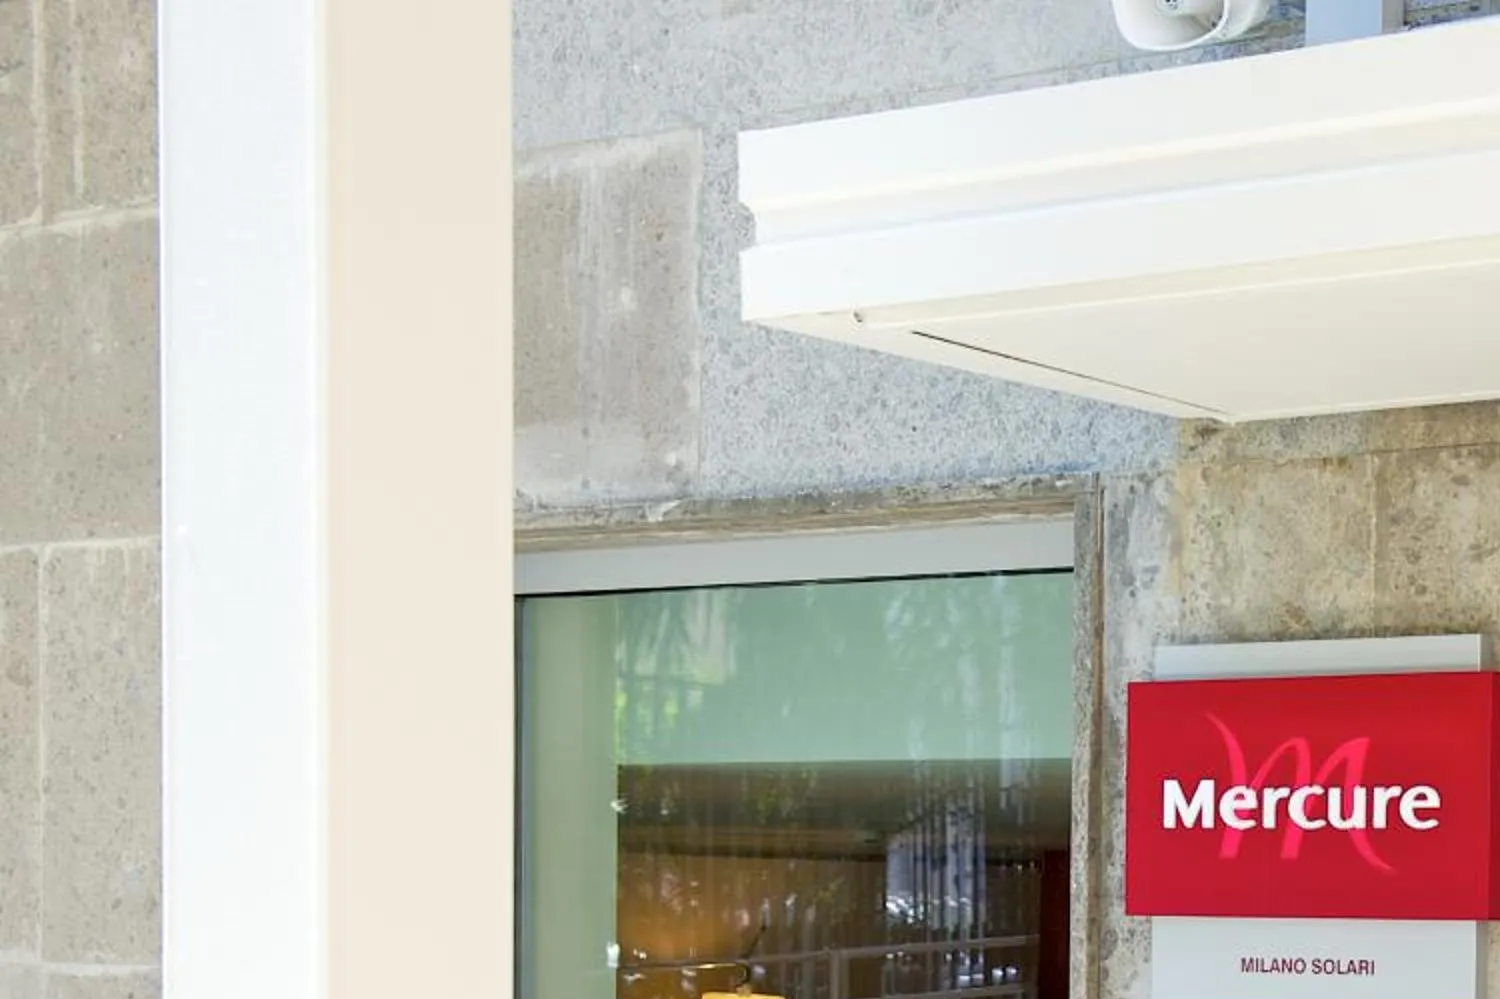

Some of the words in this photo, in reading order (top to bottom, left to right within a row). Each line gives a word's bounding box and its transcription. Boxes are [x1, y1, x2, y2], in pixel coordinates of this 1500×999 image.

[1163, 779, 1441, 830] Mercure
[1241, 957, 1307, 974] MILANO
[1311, 958, 1375, 975] SOLARI
